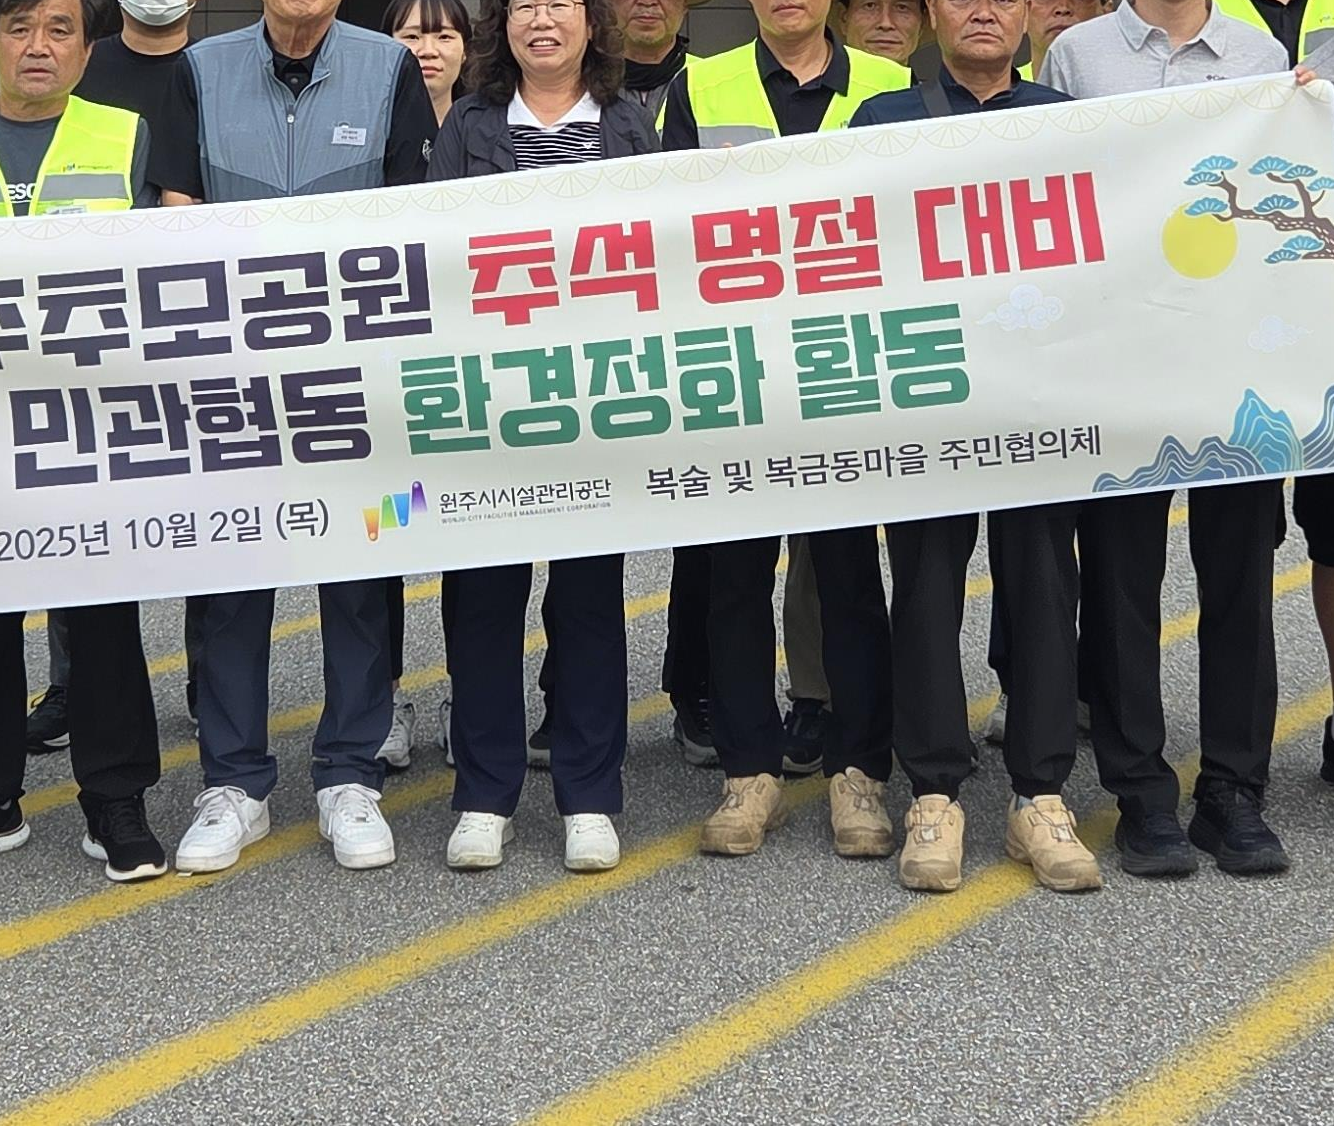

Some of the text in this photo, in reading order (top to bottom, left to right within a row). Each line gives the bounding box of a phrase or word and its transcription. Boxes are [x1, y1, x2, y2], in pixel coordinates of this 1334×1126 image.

[471, 223, 657, 323] 추석
[695, 198, 881, 301] 명절
[917, 174, 1102, 278] 대비
[9, 305, 968, 489] 민관협동 환경정화 활동
[439, 478, 612, 514] 원주시시설관리공단
[647, 425, 1100, 500] 복술 및 복금동마을 주민협의체
[125, 513, 197, 549] 10월
[210, 507, 261, 542] 2일
[277, 499, 328, 540] (목)
